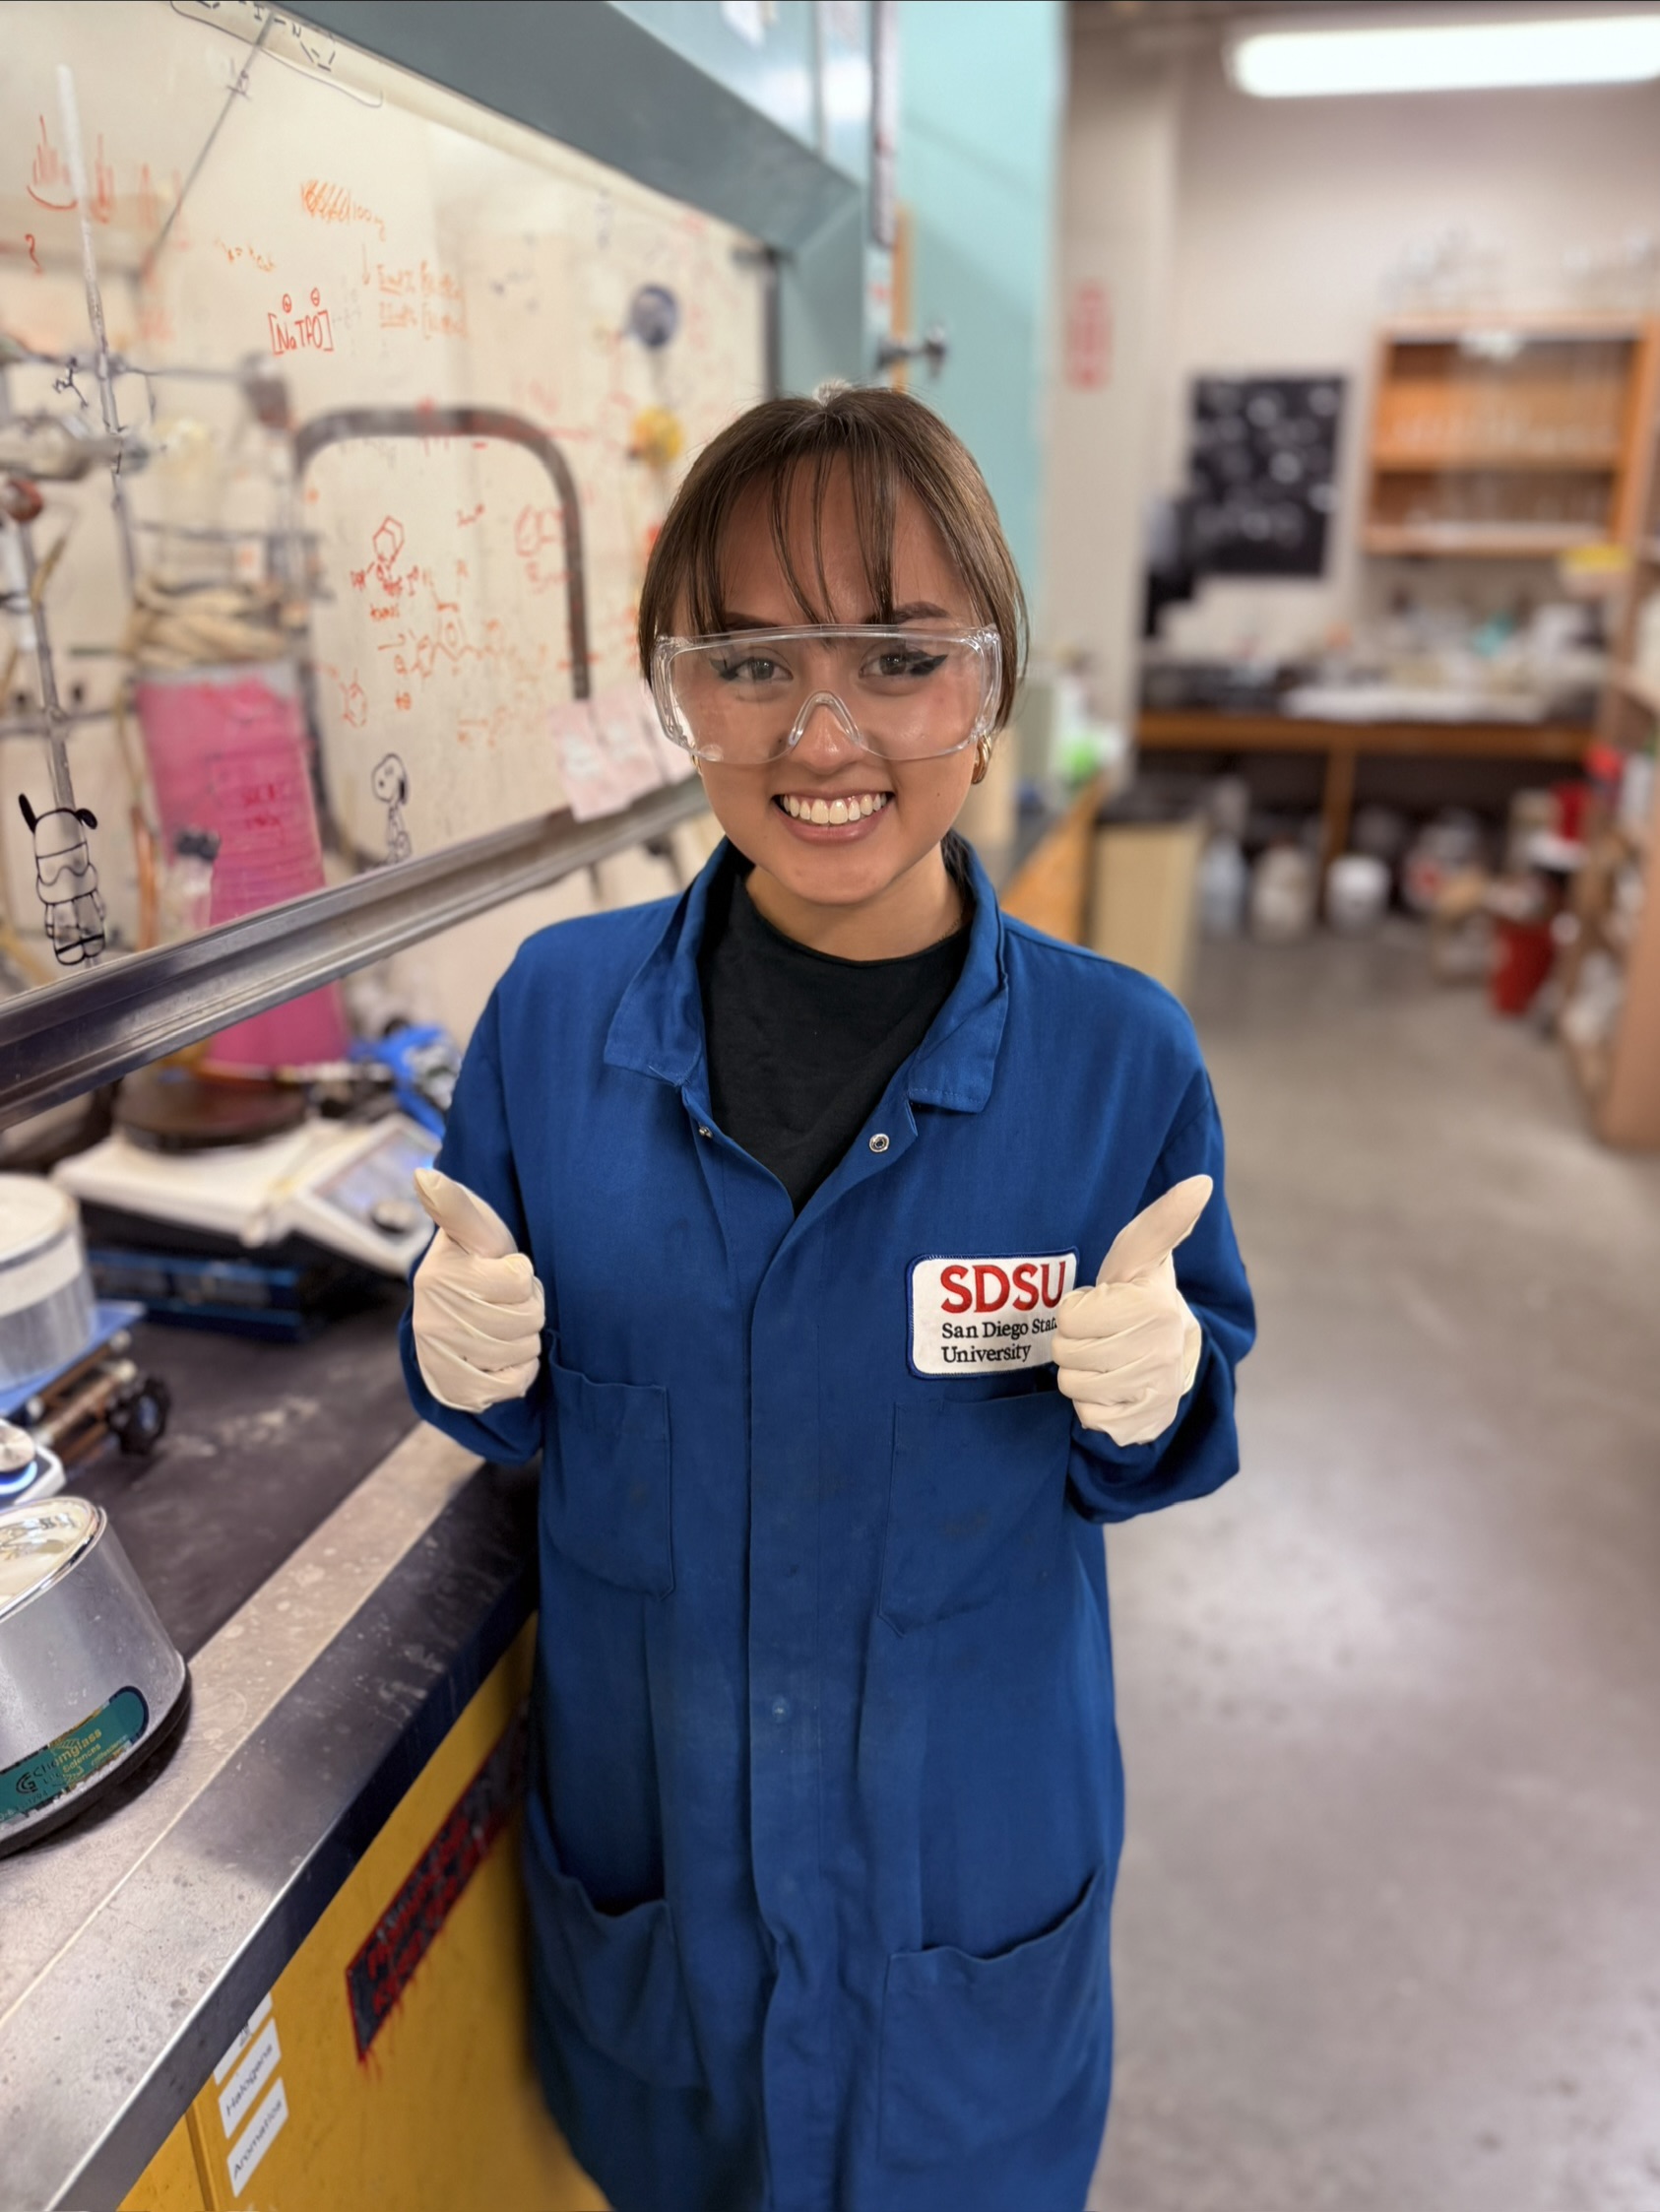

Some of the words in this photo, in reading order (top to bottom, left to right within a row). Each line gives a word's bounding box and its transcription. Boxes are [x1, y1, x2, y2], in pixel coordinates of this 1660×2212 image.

[939, 1261, 1066, 1315] SDSU
[941, 1322, 979, 1339] San
[982, 1321, 1028, 1340] Diego
[941, 1344, 1032, 1363] University
[225, 2043, 273, 2116] Halogens
